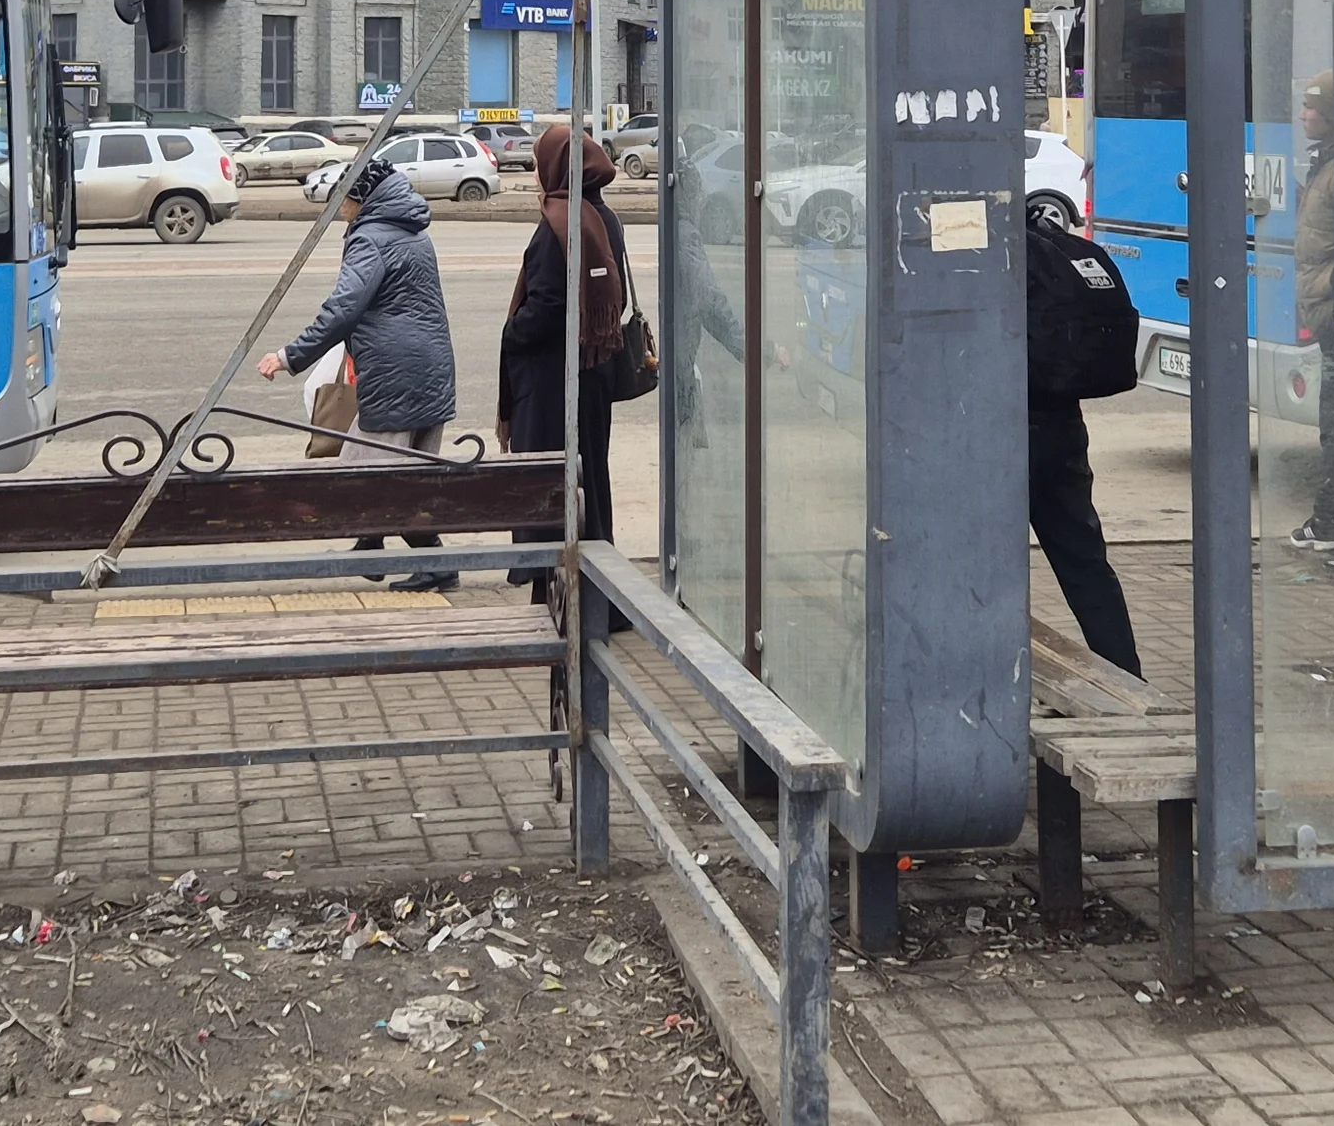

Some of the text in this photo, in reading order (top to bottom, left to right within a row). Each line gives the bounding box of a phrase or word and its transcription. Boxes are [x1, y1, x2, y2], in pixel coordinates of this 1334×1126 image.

[516, 6, 569, 24] VTB BANK
[1169, 353, 1185, 372] 696
